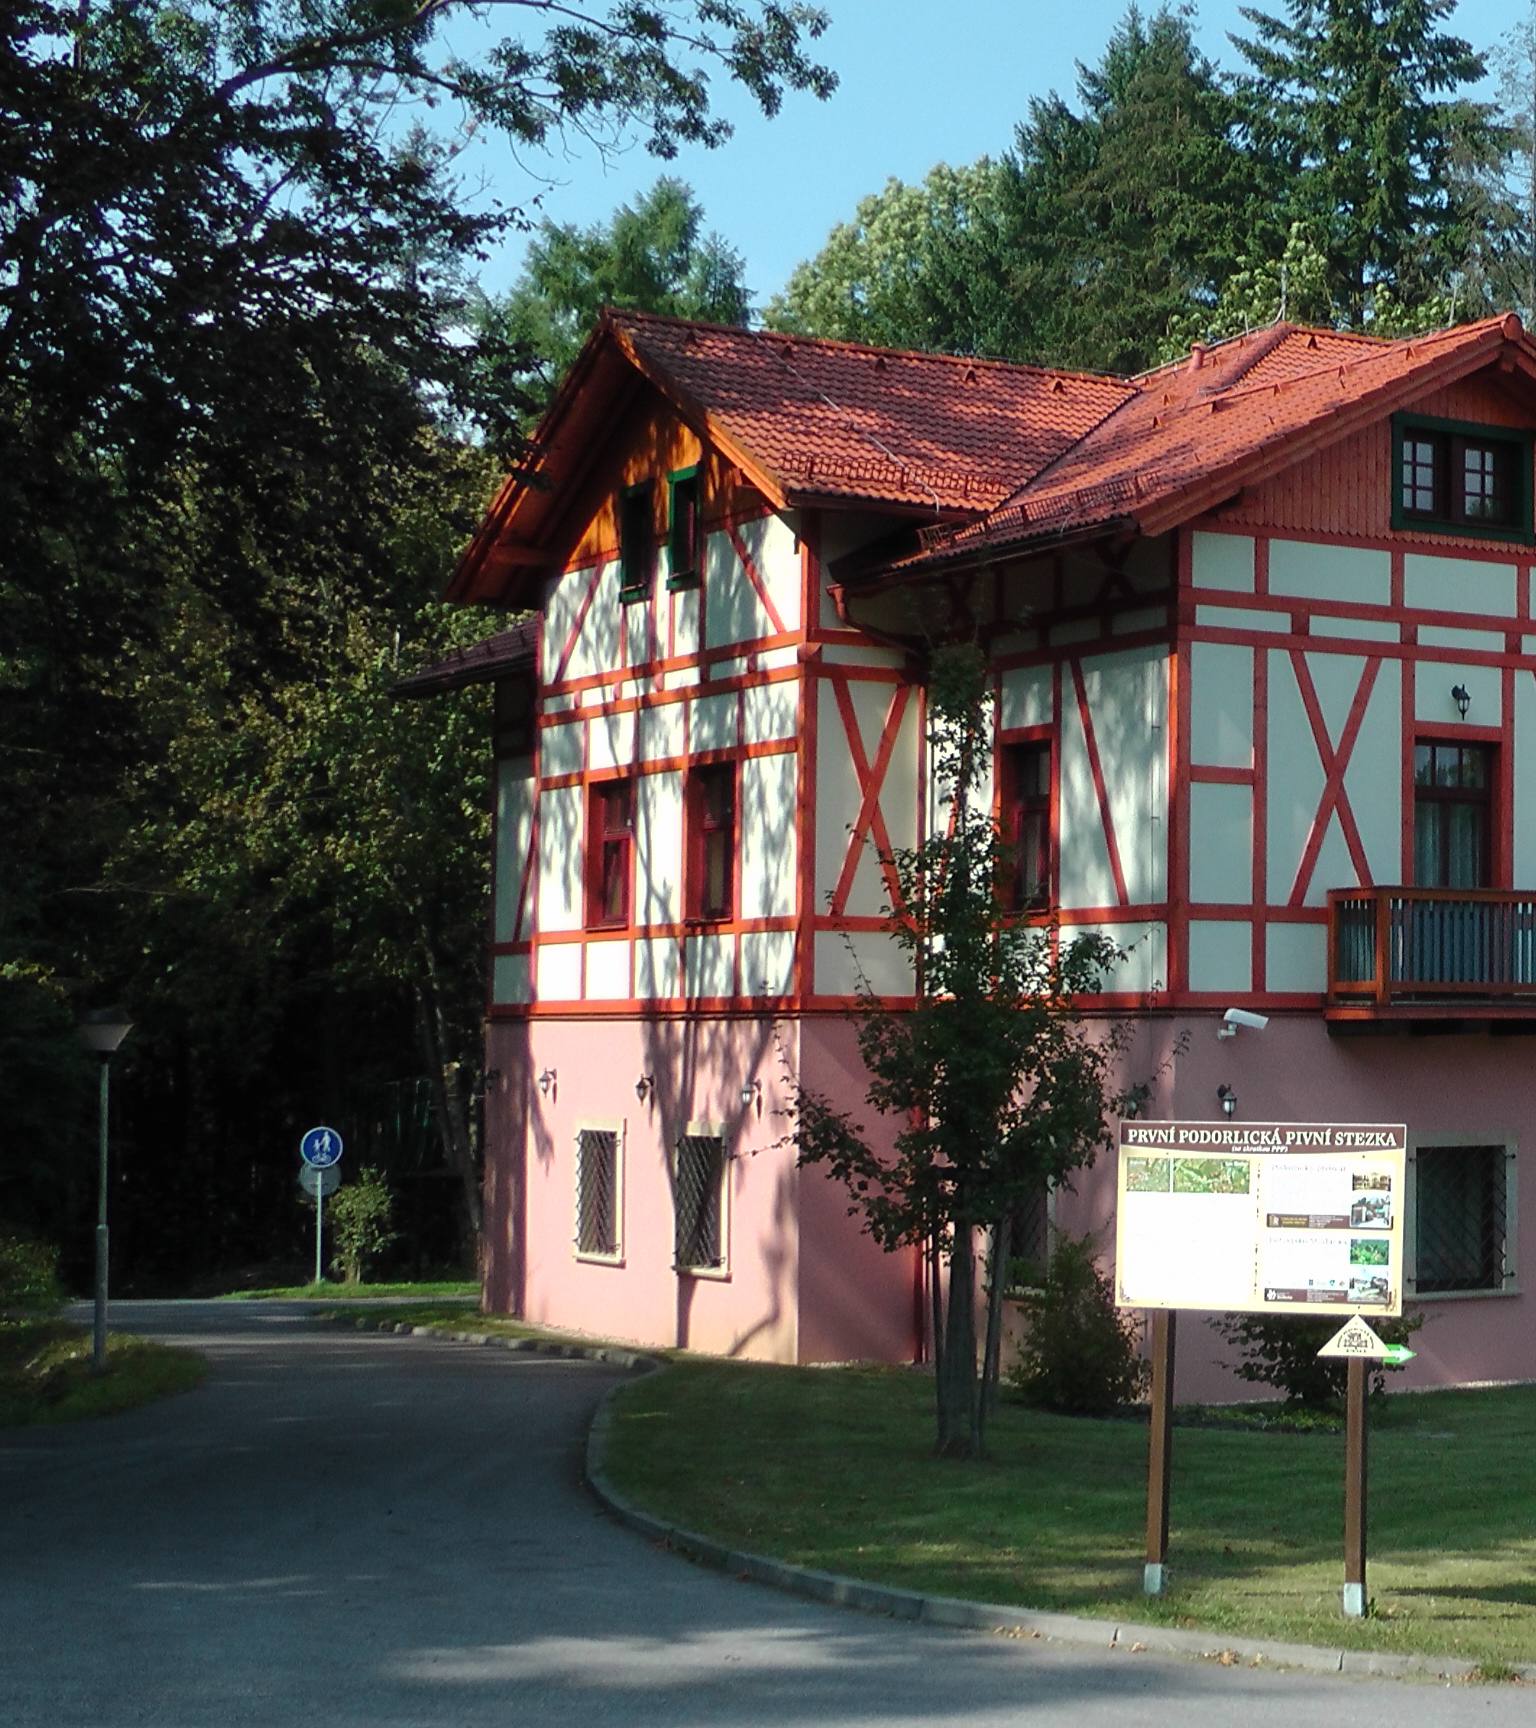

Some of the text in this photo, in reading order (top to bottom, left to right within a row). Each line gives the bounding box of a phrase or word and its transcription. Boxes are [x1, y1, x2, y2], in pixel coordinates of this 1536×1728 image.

[1127, 1125, 1397, 1147] PRVNÍ PODORLICKÁ PIVNÍ STEZKA
